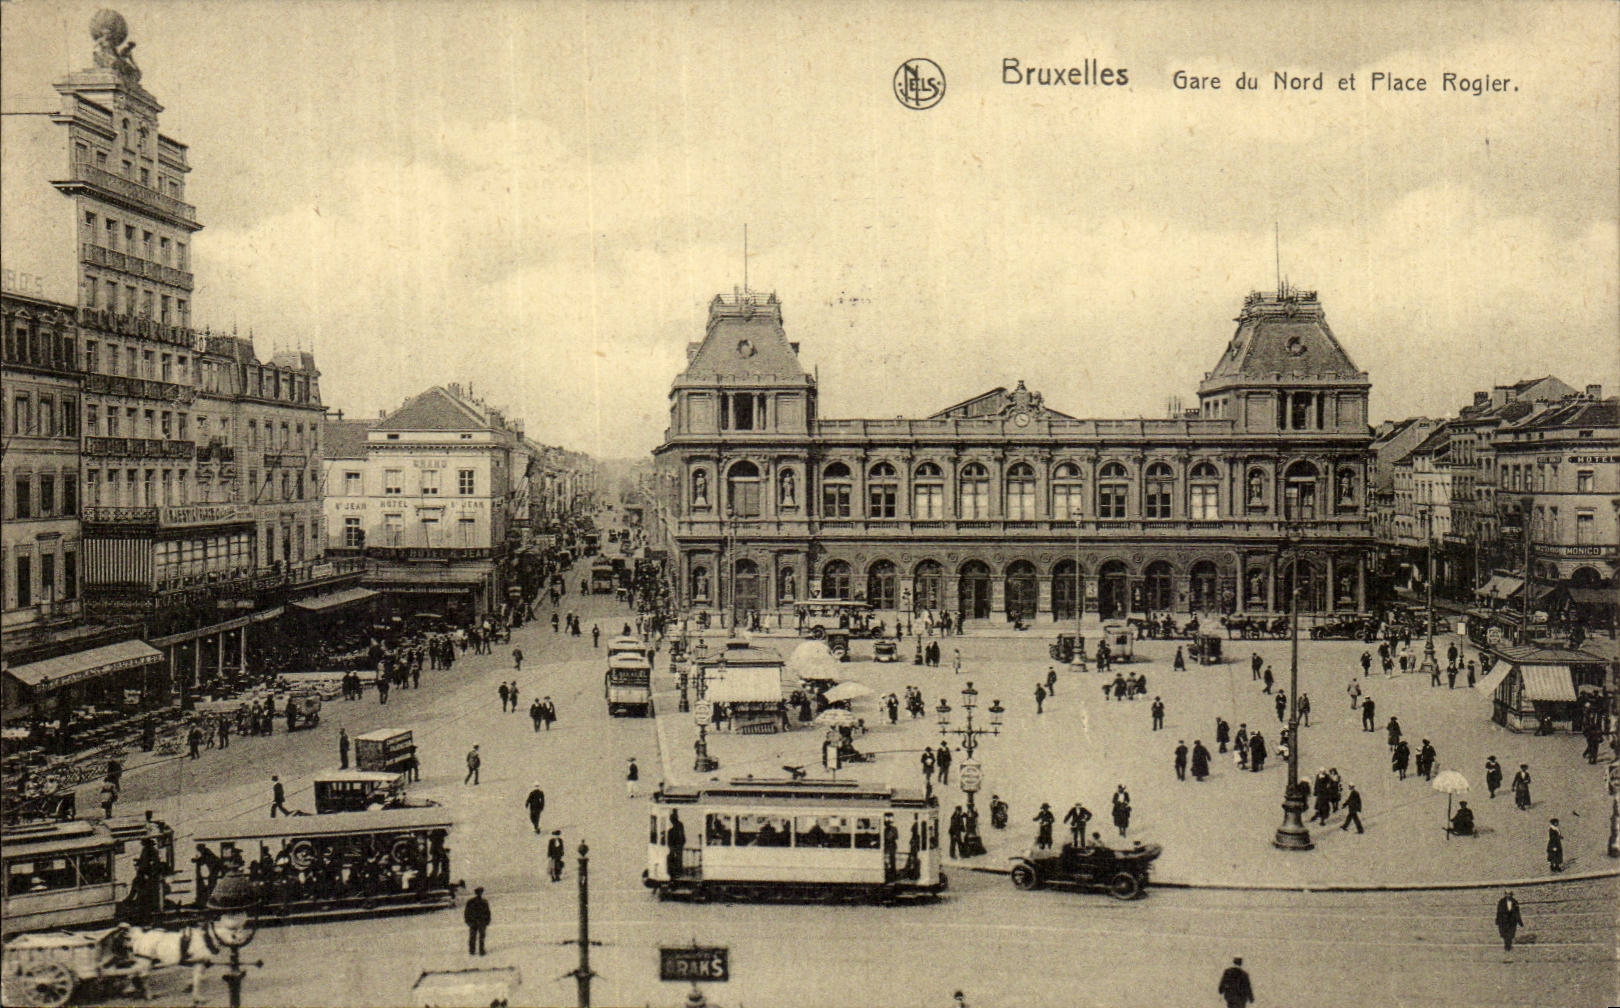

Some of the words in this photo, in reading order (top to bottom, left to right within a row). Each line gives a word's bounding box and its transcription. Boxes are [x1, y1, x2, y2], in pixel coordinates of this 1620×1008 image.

[413, 459, 448, 469] GRAND
[1577, 455, 1616, 464] HOTEL
[344, 502, 367, 511] JEAN
[380, 501, 409, 509] HOTEL
[461, 501, 485, 509] JEAN
[462, 548, 490, 558] JEAN
